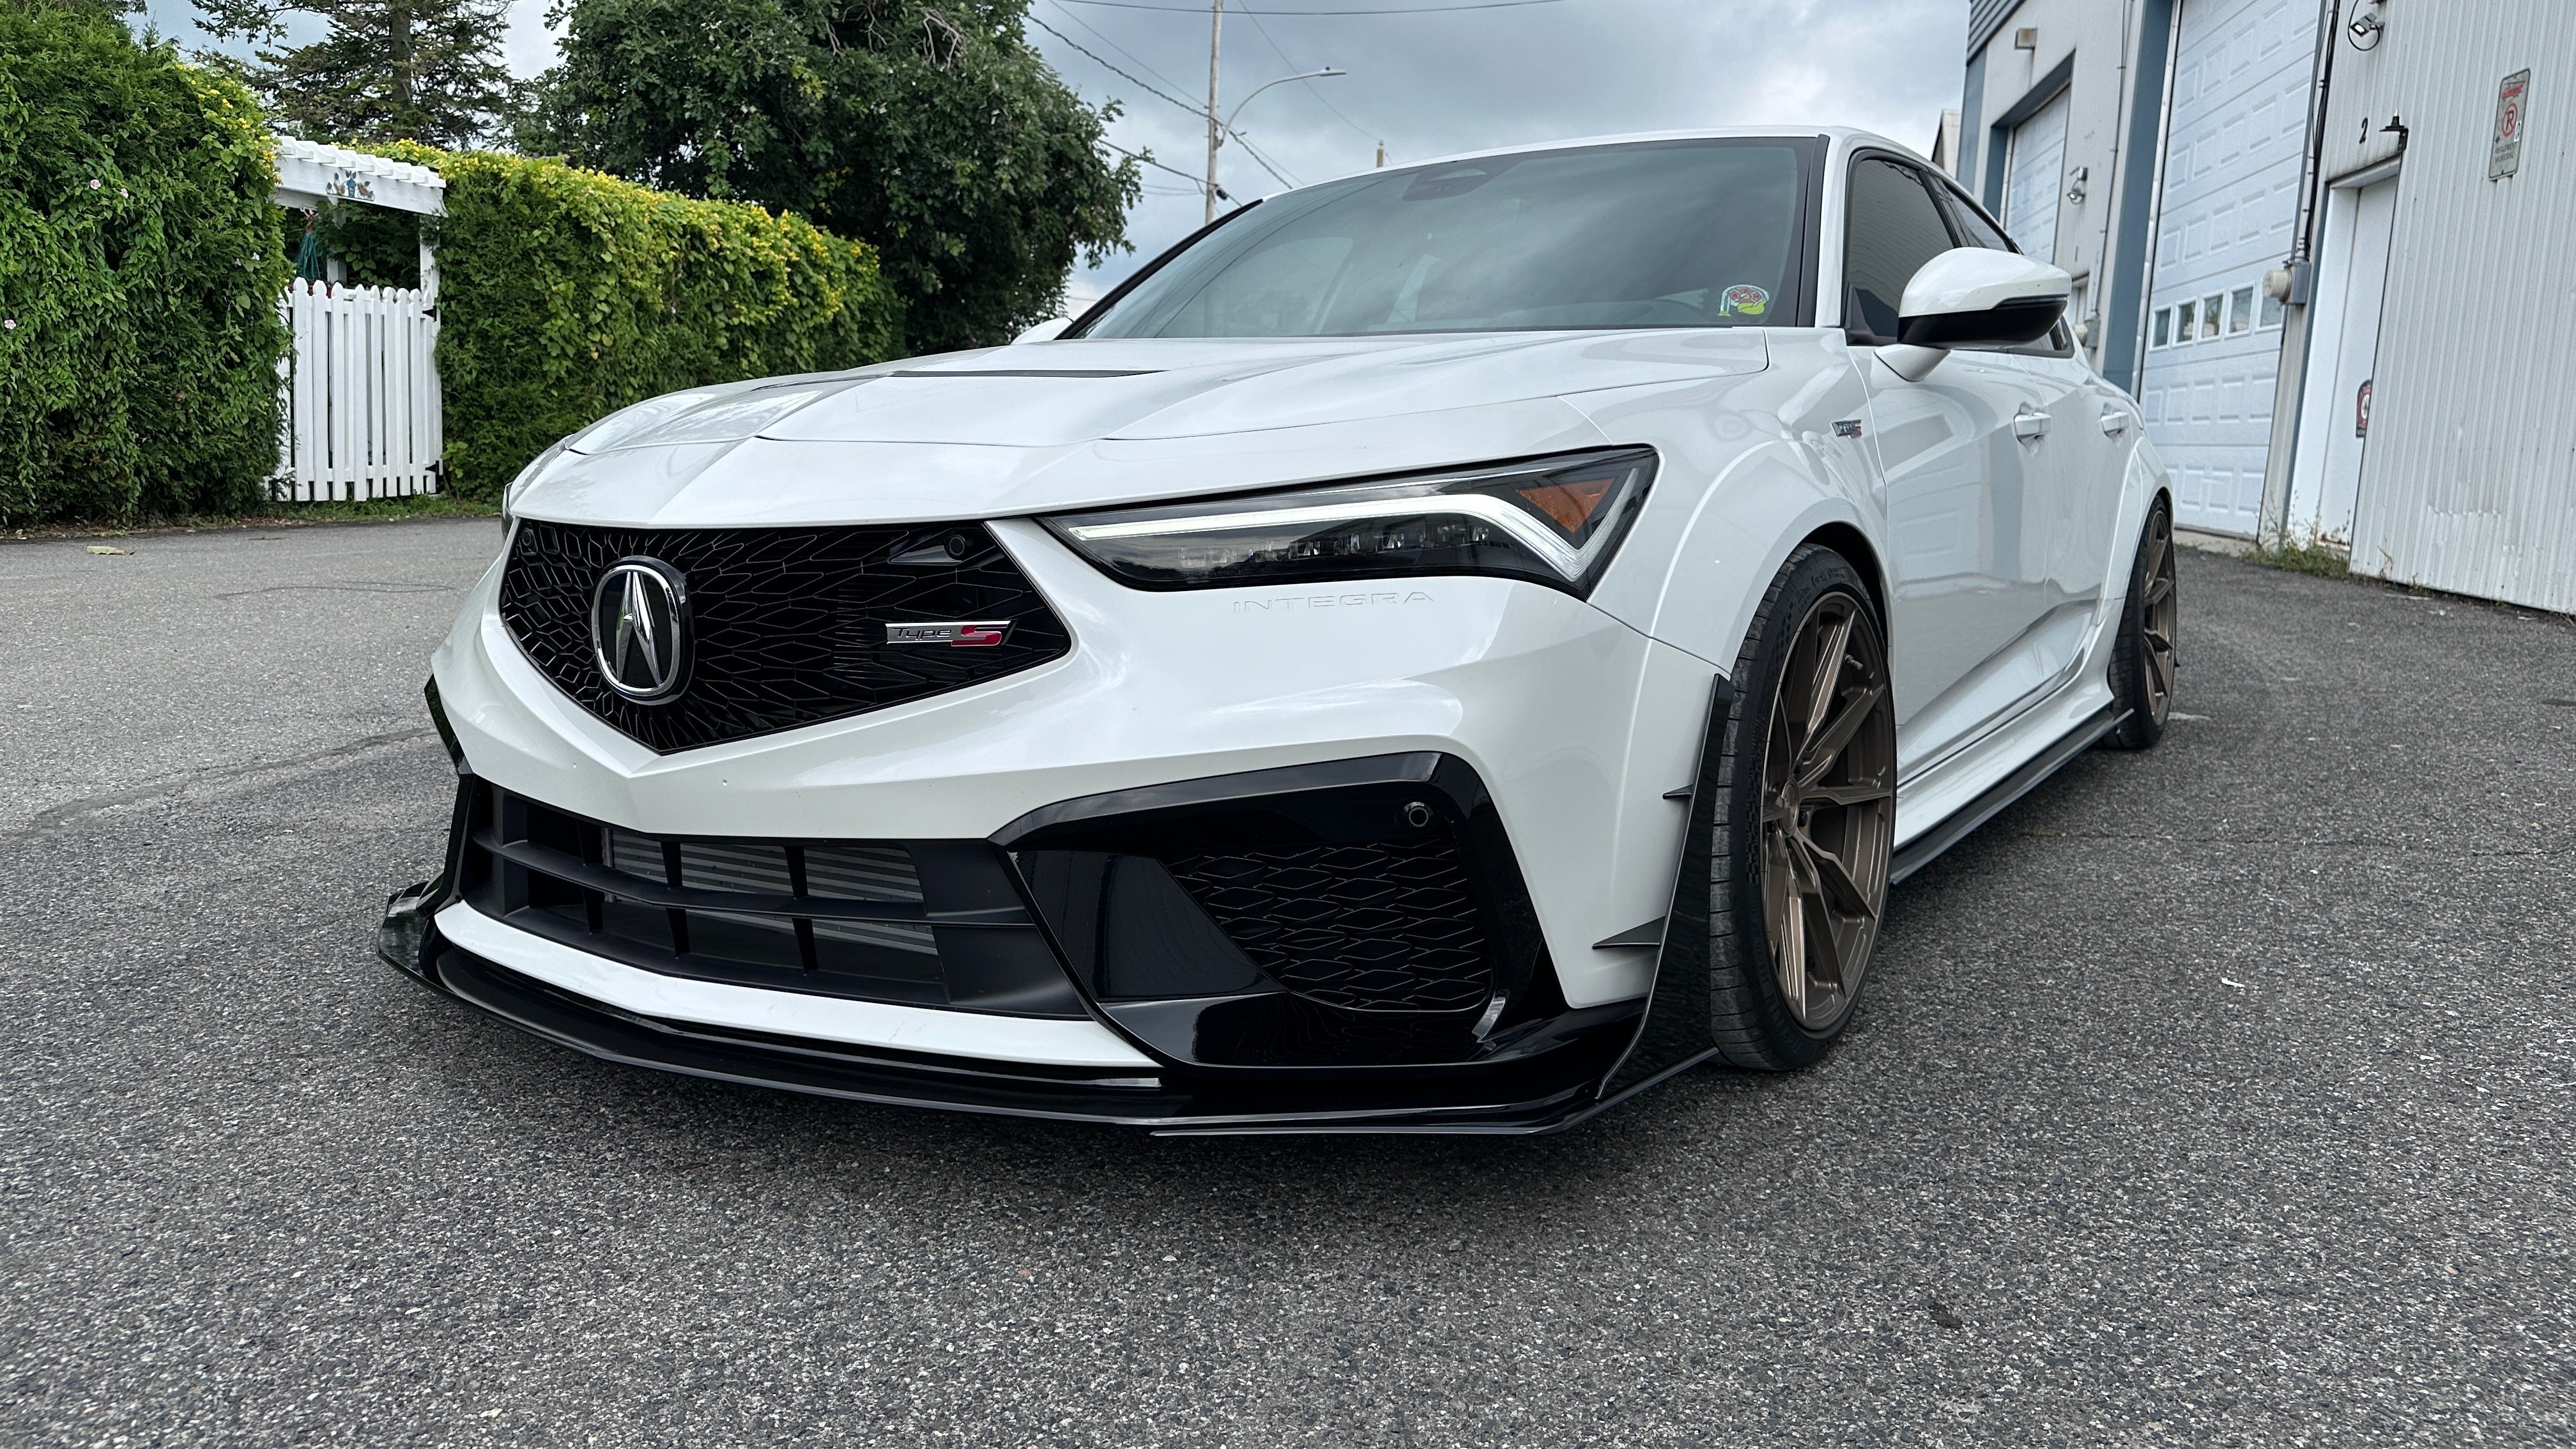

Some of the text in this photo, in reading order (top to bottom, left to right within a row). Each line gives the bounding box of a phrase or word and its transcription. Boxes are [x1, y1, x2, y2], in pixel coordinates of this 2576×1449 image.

[2359, 117, 2368, 144] 2
[1234, 592, 1434, 614] INTEGRA
[951, 624, 1009, 647] S
